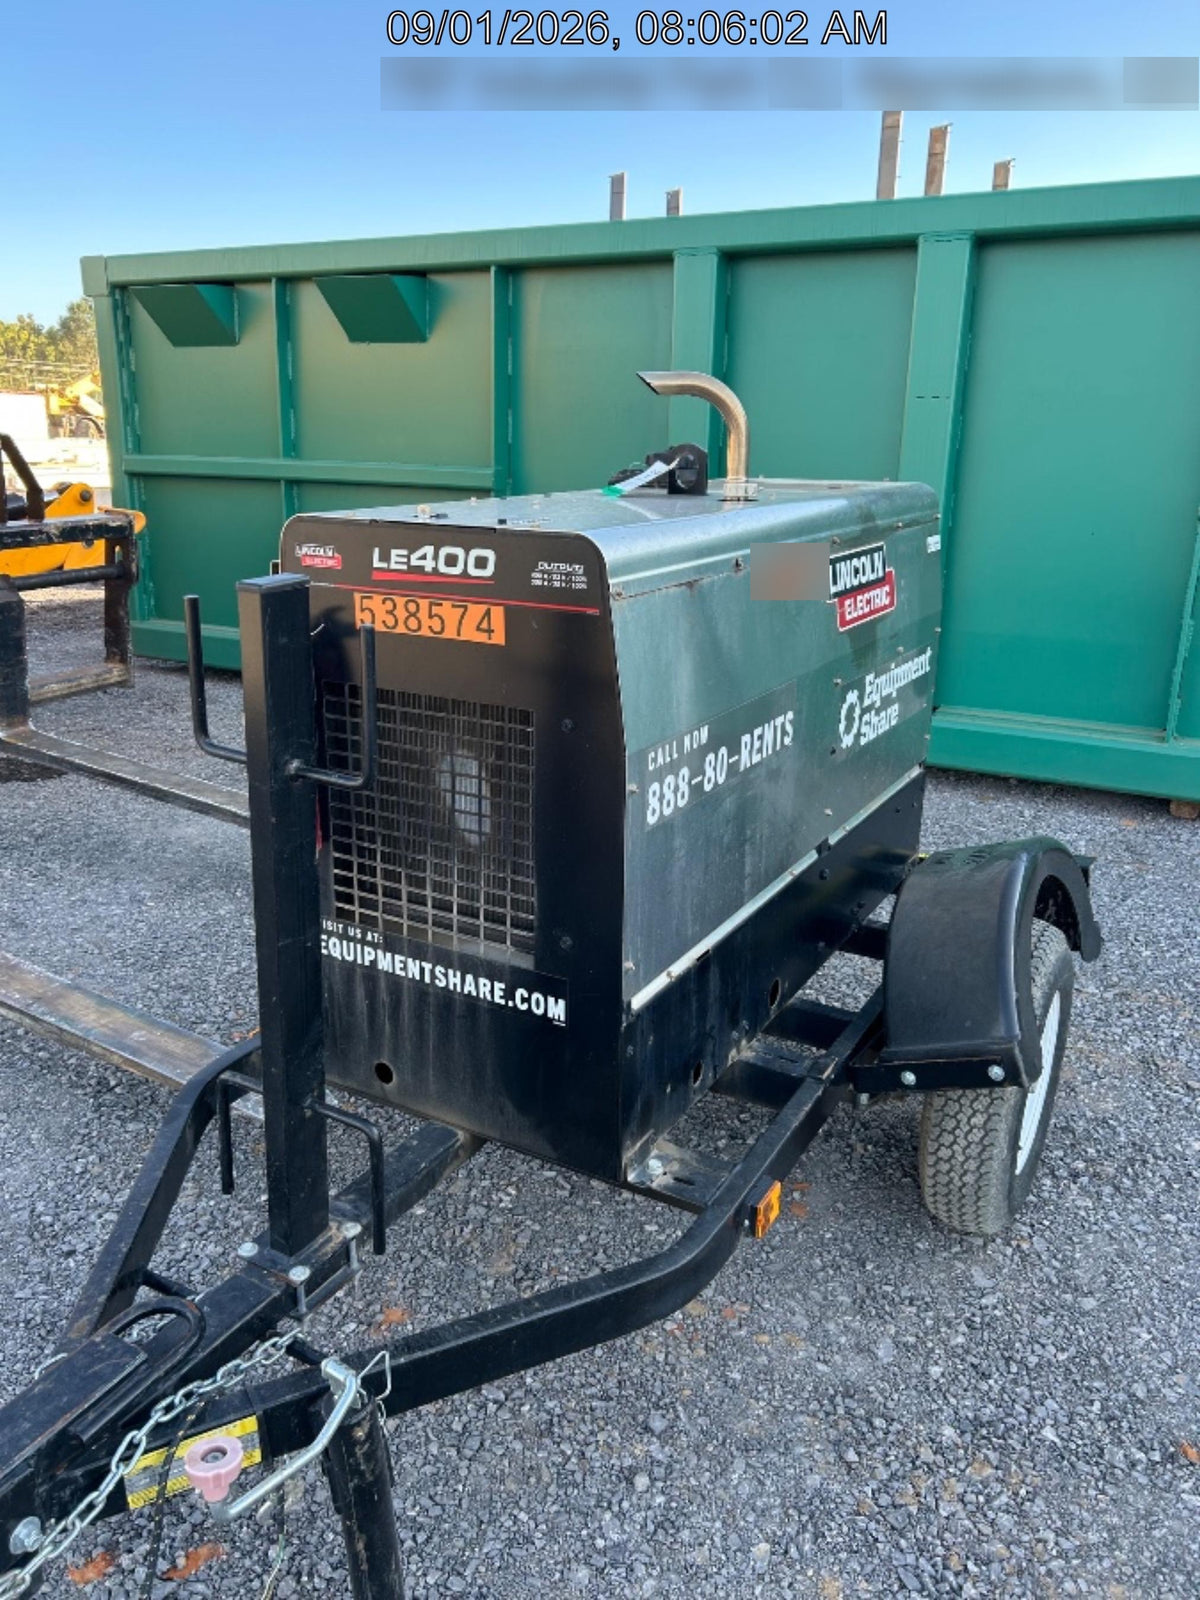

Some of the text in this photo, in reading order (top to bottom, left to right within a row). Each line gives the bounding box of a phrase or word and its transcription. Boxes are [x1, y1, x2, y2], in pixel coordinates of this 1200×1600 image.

[372, 546, 496, 577] LE400
[829, 551, 885, 594] LINCOLN
[358, 596, 496, 640] 538574
[844, 585, 890, 622] ELECTRIC
[862, 647, 932, 708] Equipment
[859, 703, 899, 746] Share
[646, 711, 794, 825] 888-80-RENTS
[648, 725, 709, 771] CALL NOW
[322, 919, 383, 943] ISIT US AT:
[320, 934, 567, 1023] EQUIPMENTSHARE.COM
